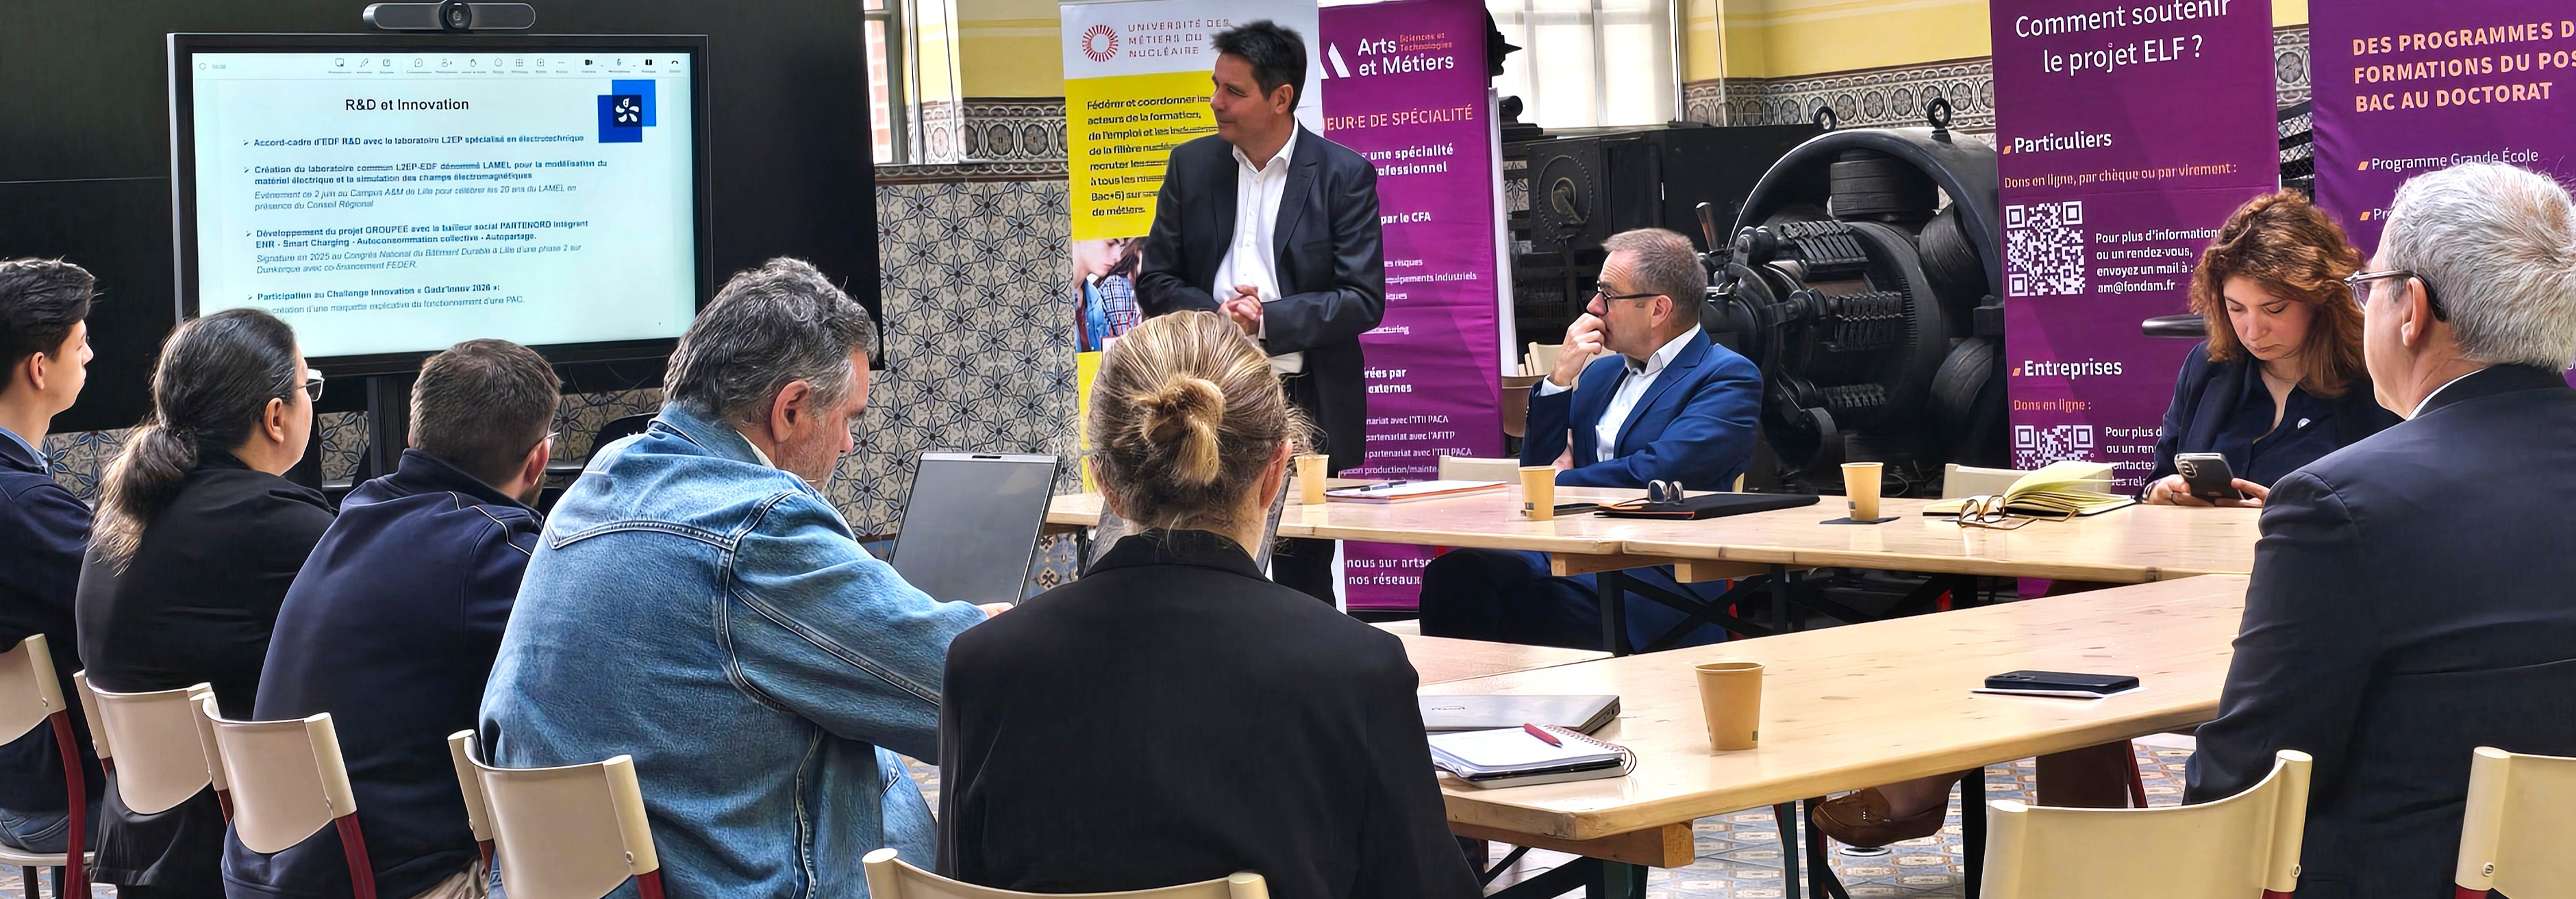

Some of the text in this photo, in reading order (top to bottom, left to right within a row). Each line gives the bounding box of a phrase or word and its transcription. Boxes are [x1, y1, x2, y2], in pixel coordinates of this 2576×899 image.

[1127, 18, 1229, 32] UNIVERSITÉ DES
[2015, 0, 2231, 38] Comment soutenir
[1128, 33, 1202, 45] MÉTIERS DU
[1357, 37, 1397, 56] Arts
[2352, 36, 2392, 56] DES
[2398, 22, 2553, 52] PROGRAMMES
[1129, 46, 1199, 58] NUCLÉAIRE
[2043, 34, 2203, 77] le projet ELF ?
[1358, 52, 1455, 77] et Métiers
[2353, 56, 2494, 84] FORMATIONS
[2500, 53, 2531, 73] DU
[345, 98, 470, 111] R&D et Innovation
[1137, 96, 1198, 107] coordonner
[2355, 81, 2553, 113] BAC AU DOCTORAT
[1088, 110, 1201, 125] acteurs de la formation,
[1370, 113, 1388, 128] DE
[1392, 103, 1473, 126] SPÉCIALITÉ
[2014, 130, 2113, 154] Particuliers
[1370, 150, 1392, 161] une
[1395, 142, 1453, 161] spécialité
[483, 161, 512, 170] LAMEL
[2371, 147, 2539, 173] Programme Grande École
[1375, 161, 1448, 177] ofessionnel
[2004, 162, 2231, 189] Dons en ligne, par chèque ou par virement
[1380, 212, 1432, 227] par le CFA
[283, 239, 309, 248] Smart
[310, 238, 350, 249] Charging
[2095, 232, 2121, 244] Pour
[2121, 230, 2144, 245] plus
[2096, 247, 2193, 260] ou un rendez-vous,
[1395, 259, 1424, 268] risques
[2097, 261, 2189, 279] envoyez un mail à
[1435, 271, 1477, 282] industriels
[257, 292, 312, 301] Participation
[371, 288, 415, 296] Innovation
[2097, 279, 2176, 295] am@fondam.fr
[1389, 368, 1408, 380] par
[2024, 357, 2123, 380] Entreprises
[1368, 383, 1412, 394] externes
[2014, 398, 2086, 414] Dons en ligne
[1428, 415, 1449, 424] PACA
[2105, 426, 2130, 438] Pour
[2131, 425, 2153, 440] plus
[1368, 449, 1412, 459] partenariat
[1451, 447, 1473, 457] PACA
[2106, 445, 2120, 454] ou
[2121, 444, 2135, 454] un
[1347, 558, 1376, 569] nous
[1379, 558, 1398, 568] sur
[1349, 572, 1421, 585] nos réseaux
